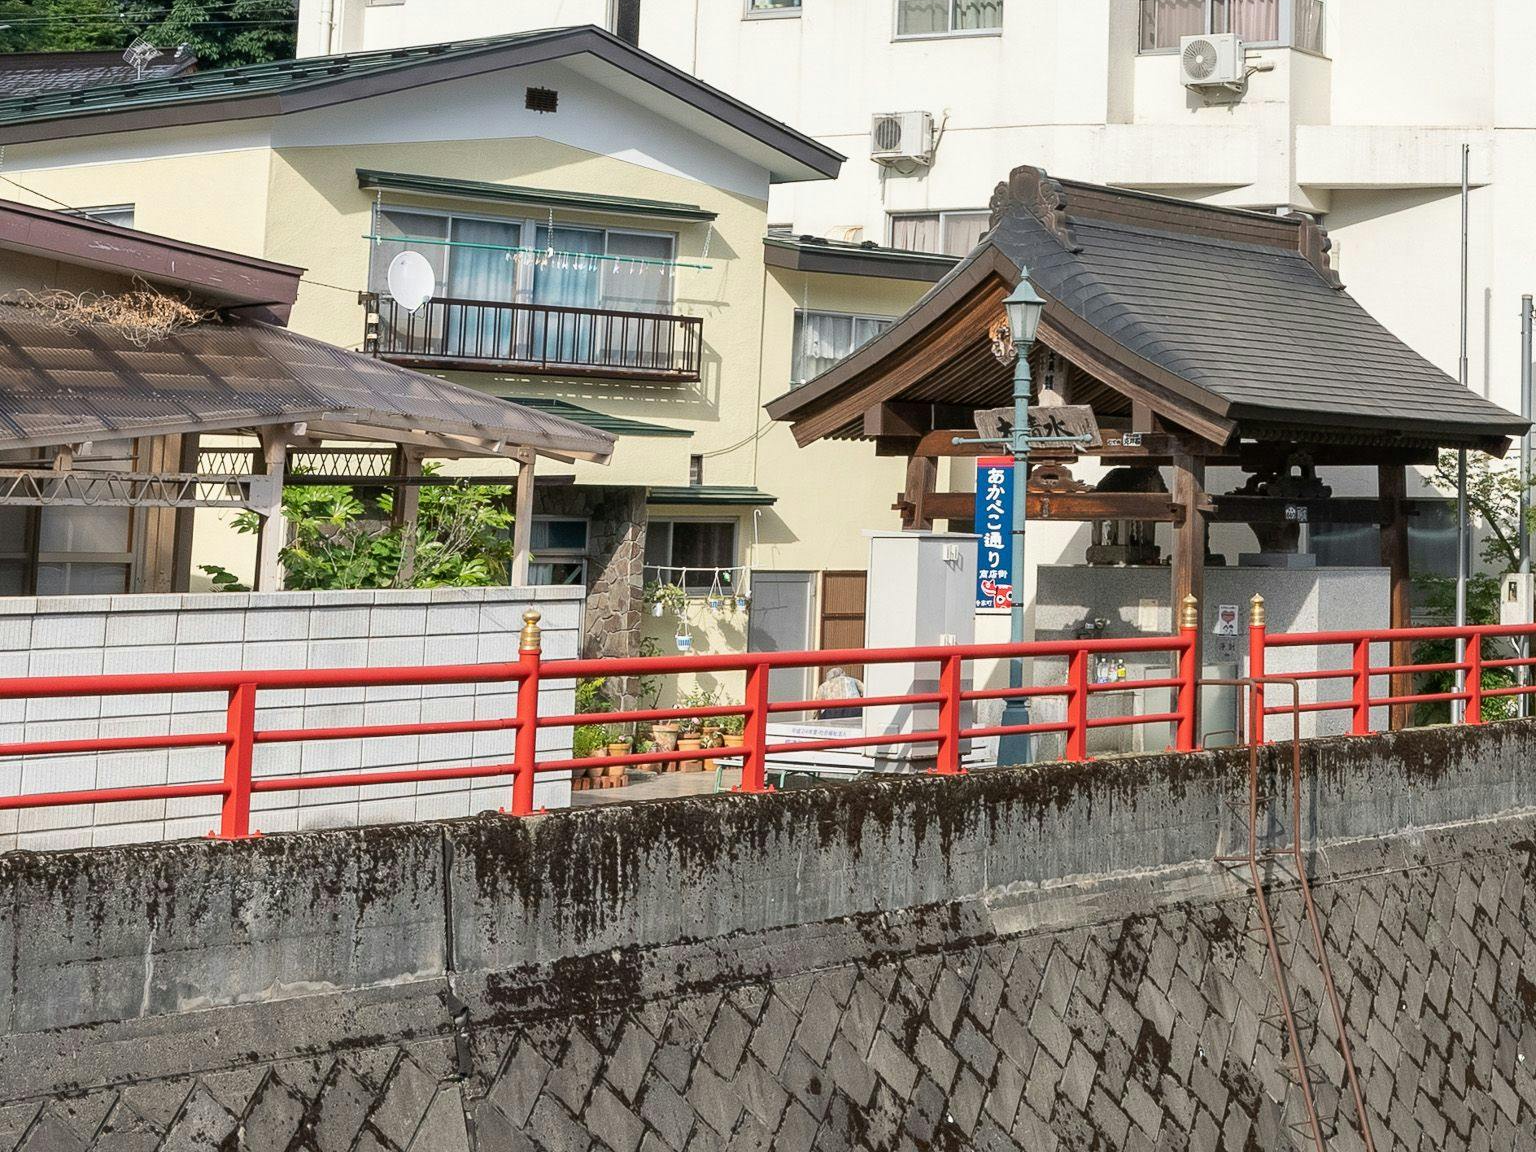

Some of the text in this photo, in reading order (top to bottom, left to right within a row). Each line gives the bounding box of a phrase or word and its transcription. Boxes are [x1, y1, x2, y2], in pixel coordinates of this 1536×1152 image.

[984, 468, 1006, 568] あかべこ通り
